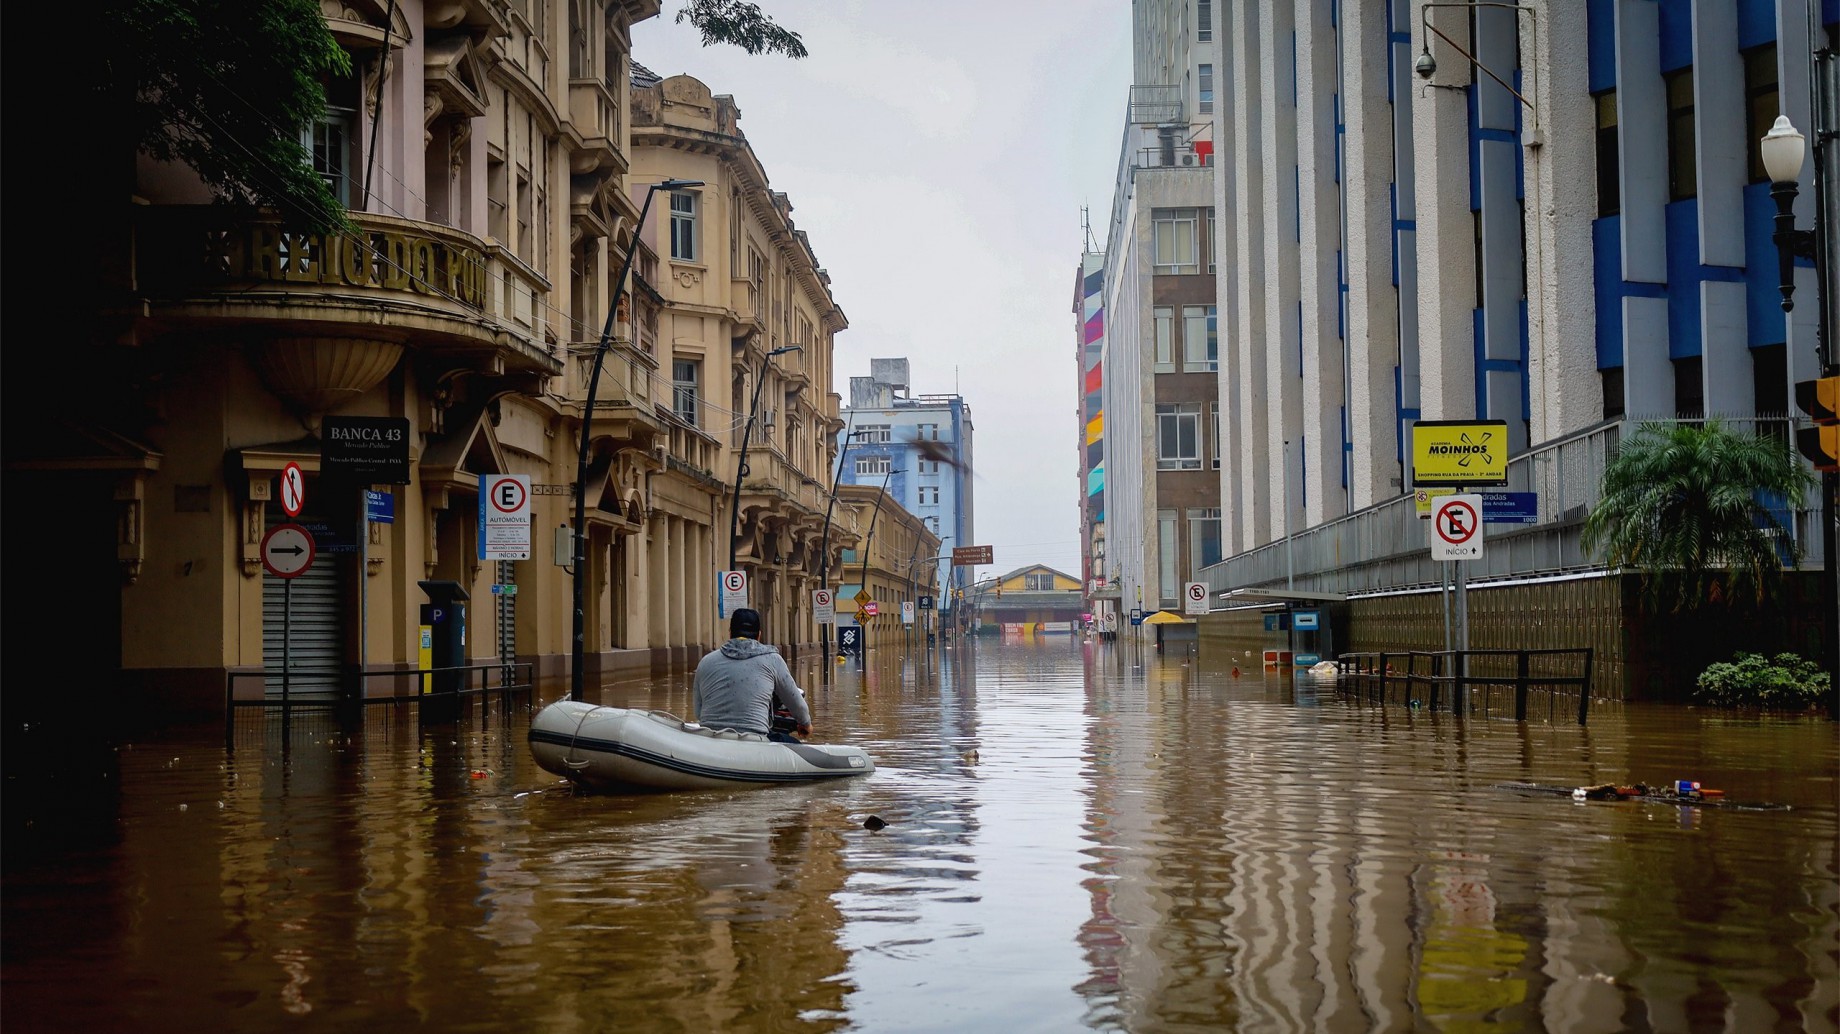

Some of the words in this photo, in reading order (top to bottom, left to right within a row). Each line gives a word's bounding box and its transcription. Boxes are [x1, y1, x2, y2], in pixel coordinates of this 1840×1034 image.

[234, 226, 372, 287] REIO
[384, 232, 435, 295] DO
[330, 427, 382, 440] BANCA
[385, 428, 402, 441] 43
[1428, 445, 1487, 454] MOINHOS
[502, 486, 515, 505] E
[1449, 510, 1464, 534] E
[1445, 547, 1468, 555] INÍCIO
[731, 576, 739, 587] E
[433, 609, 443, 621] P
